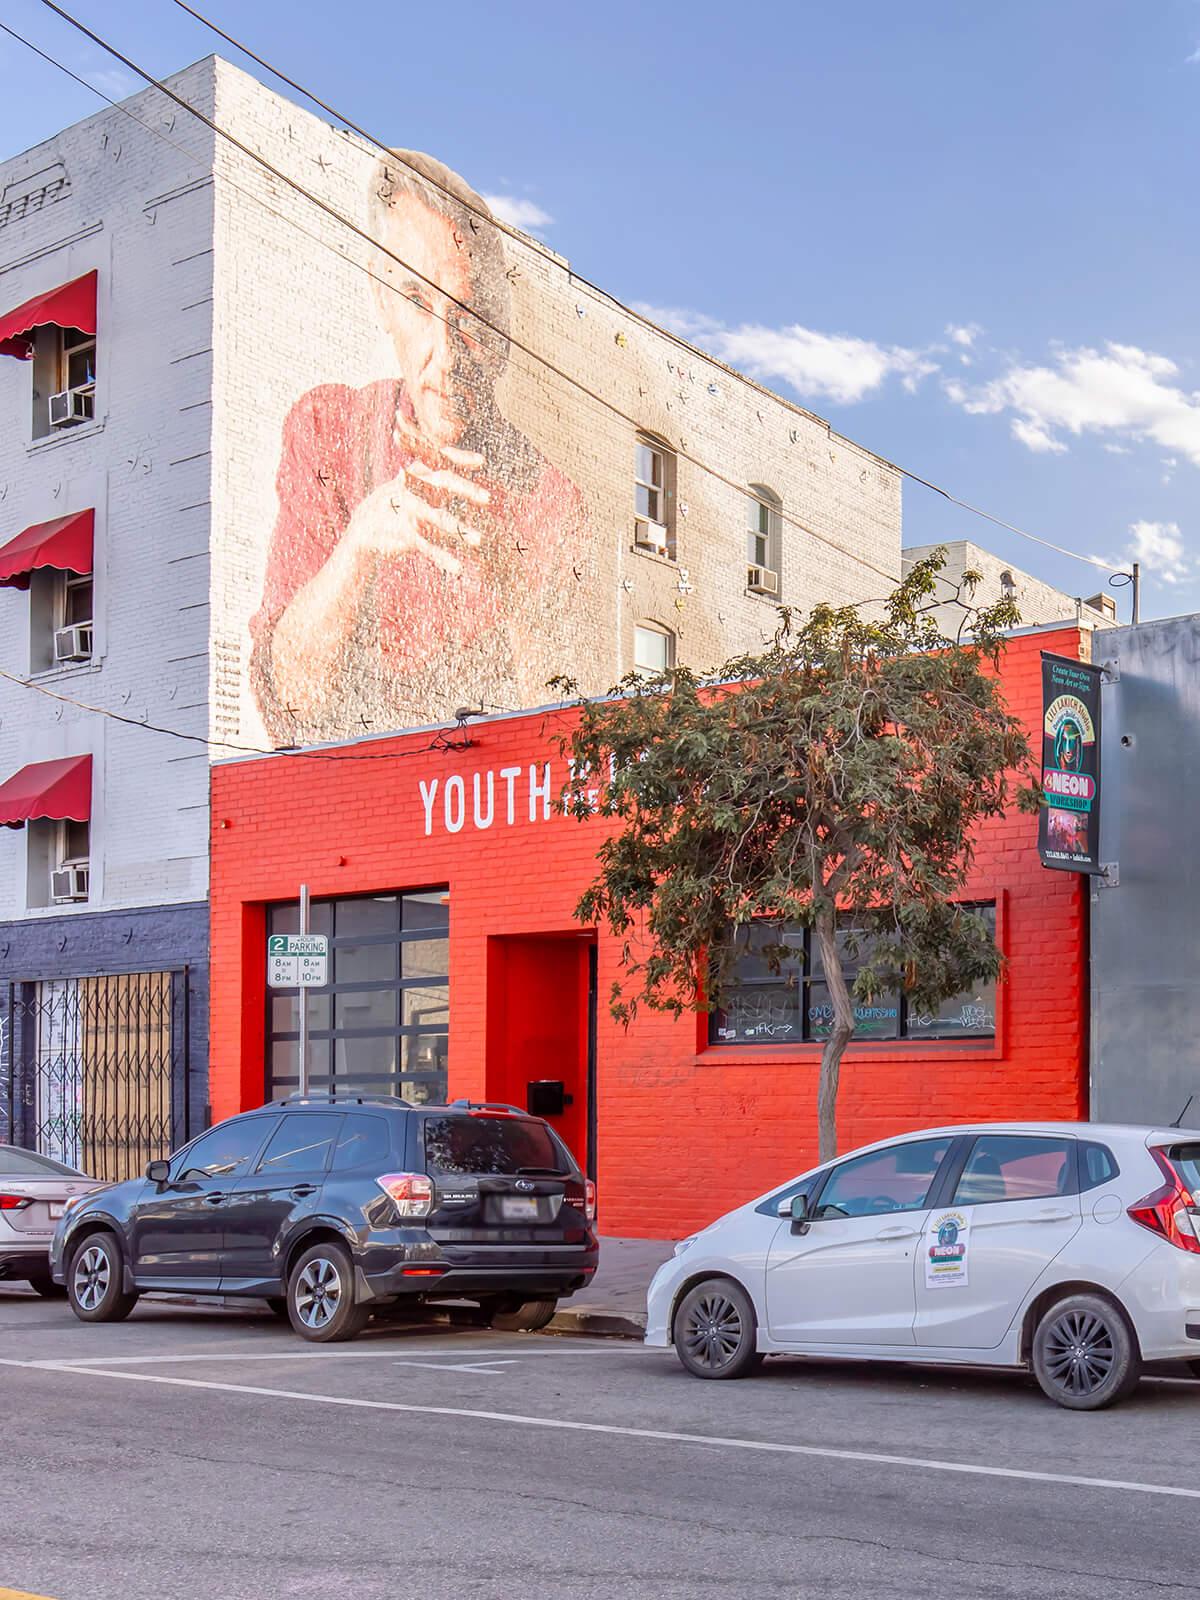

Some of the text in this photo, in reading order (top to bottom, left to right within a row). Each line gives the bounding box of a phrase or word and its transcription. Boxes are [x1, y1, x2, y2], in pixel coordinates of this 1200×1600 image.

[1052, 664, 1068, 676] Create
[1052, 772, 1088, 797] NEON
[418, 762, 551, 836] YOUTH
[274, 938, 284, 950] 2
[290, 943, 324, 952] PARKING
